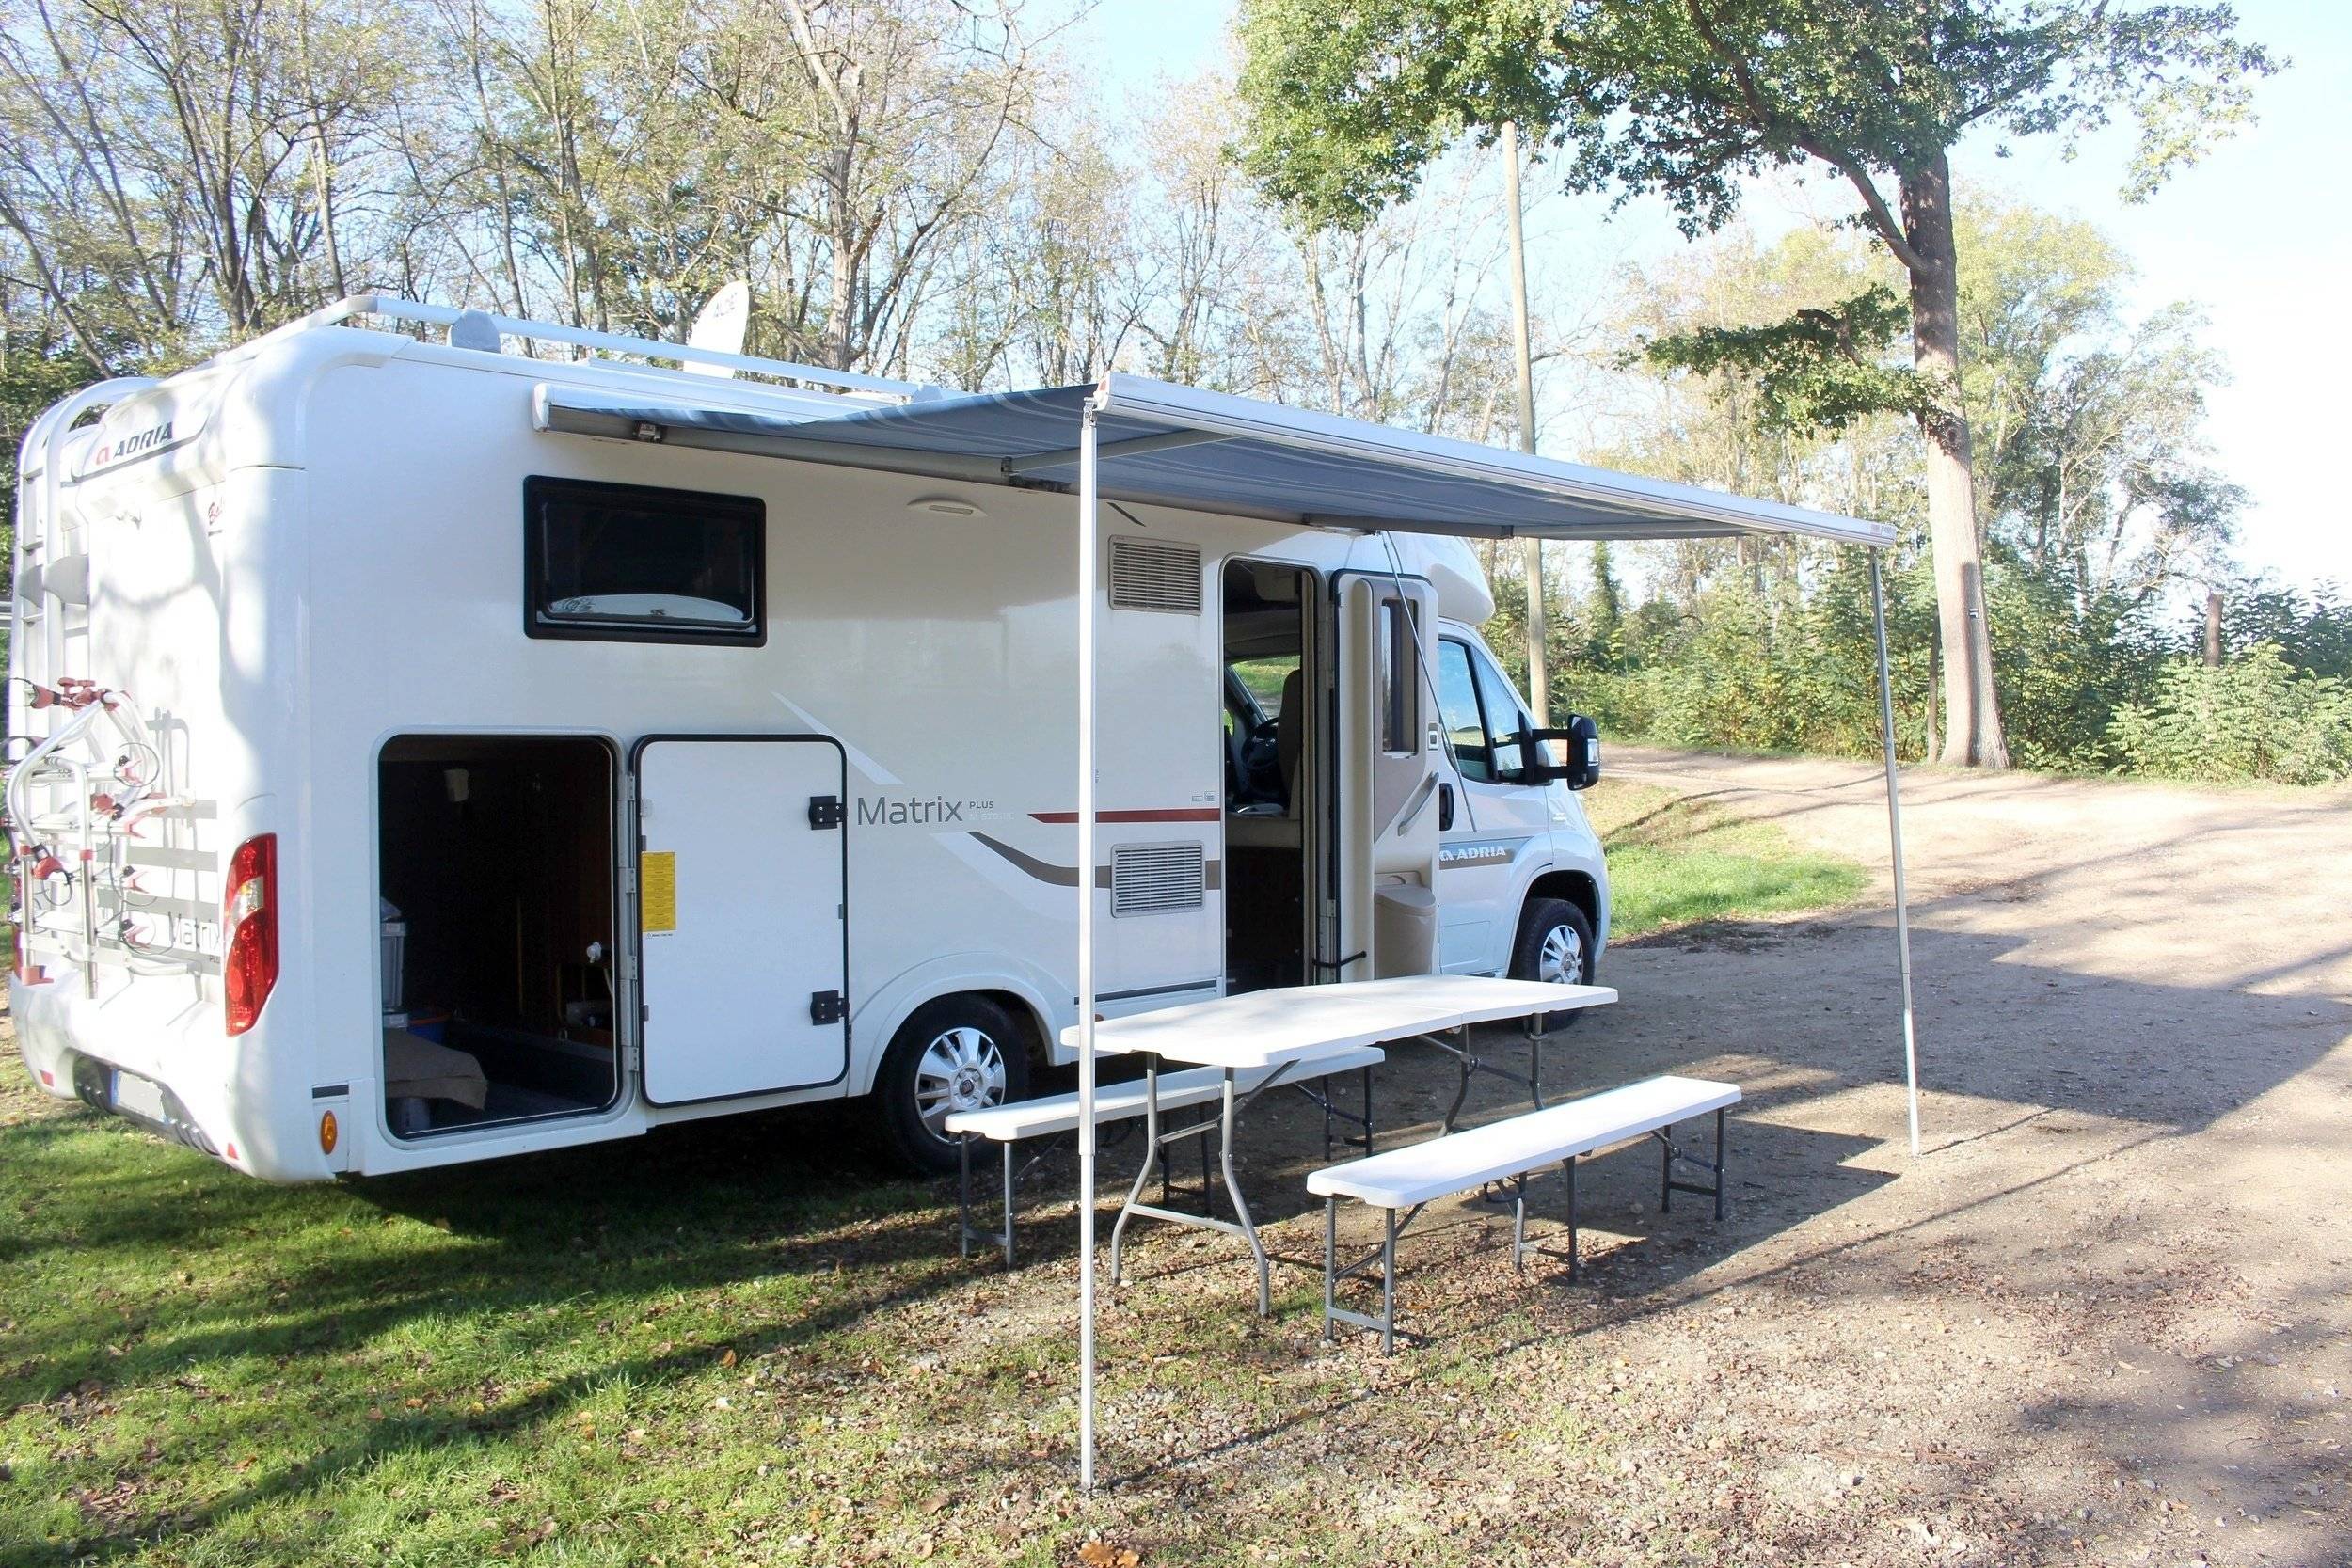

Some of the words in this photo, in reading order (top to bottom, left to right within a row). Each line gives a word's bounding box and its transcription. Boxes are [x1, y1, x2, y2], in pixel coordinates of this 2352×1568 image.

[113, 421, 173, 459] ADRIA
[857, 796, 963, 825] Matrix
[969, 800, 994, 809] PLUS
[1456, 846, 1506, 861] ADRIA
